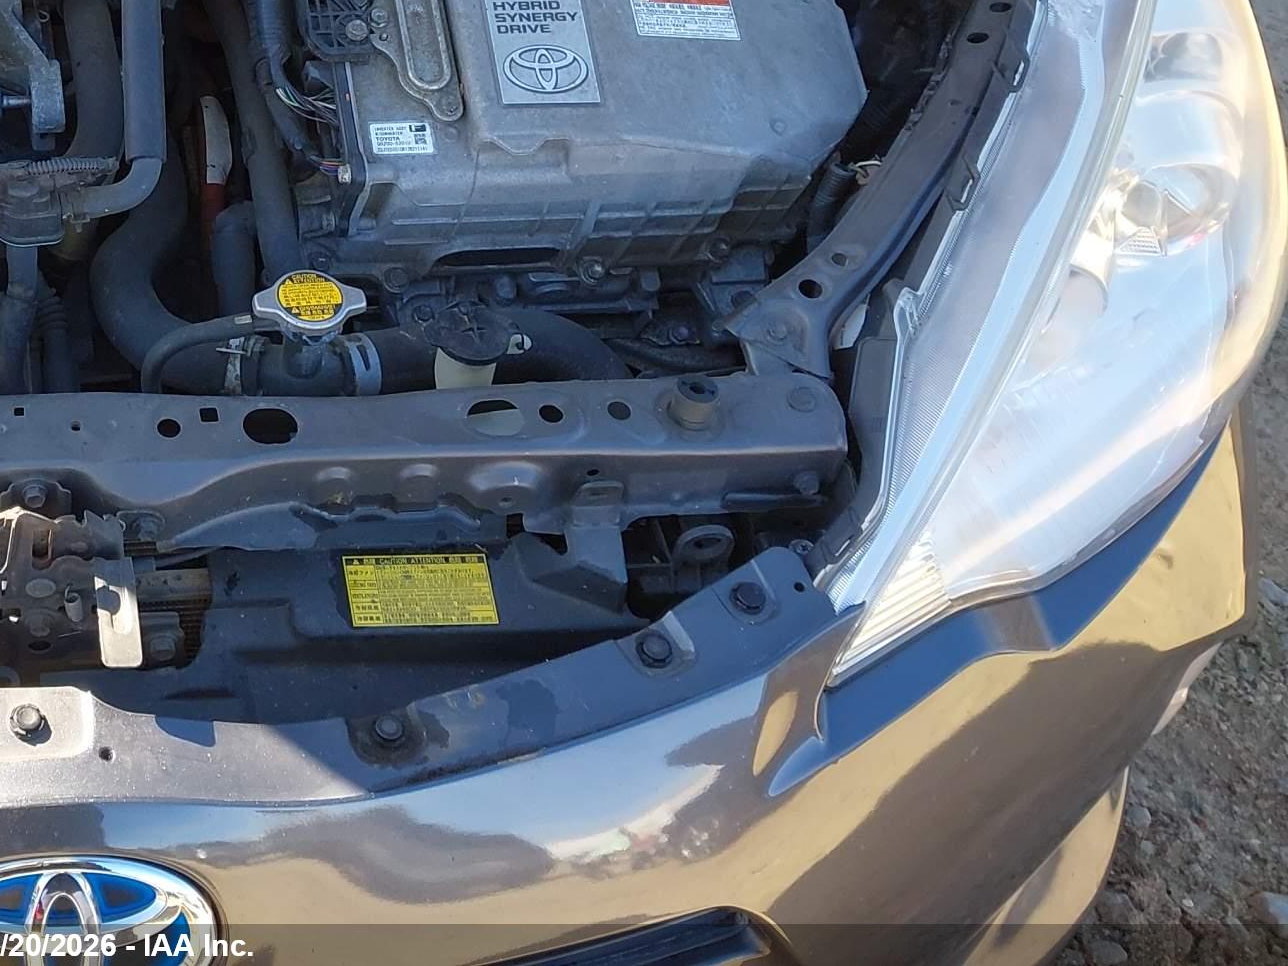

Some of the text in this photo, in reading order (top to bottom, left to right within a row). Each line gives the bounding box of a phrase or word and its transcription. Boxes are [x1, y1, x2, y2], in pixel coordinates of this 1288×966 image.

[493, 0, 561, 11] HYBRID
[494, 11, 579, 23] SYNERGY
[497, 23, 552, 35] DRIVE
